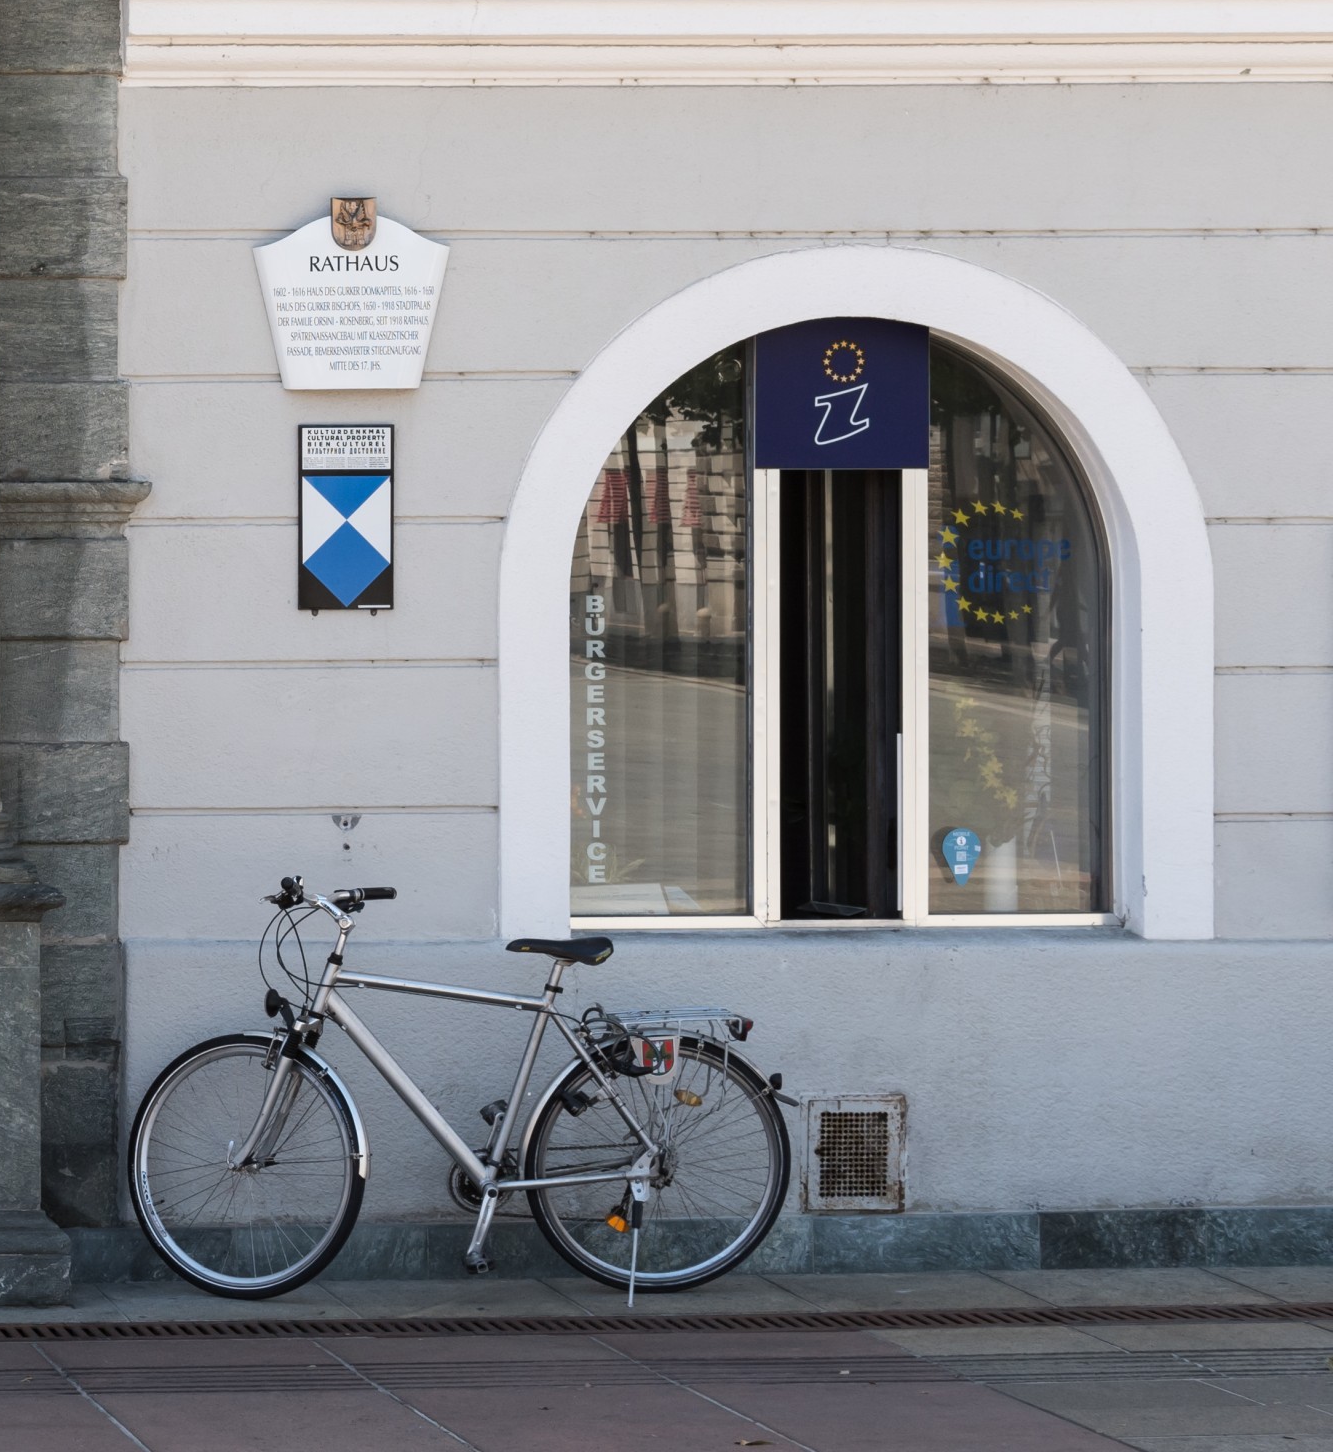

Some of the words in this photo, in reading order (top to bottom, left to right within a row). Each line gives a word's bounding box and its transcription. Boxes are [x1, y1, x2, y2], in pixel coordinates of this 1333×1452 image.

[310, 255, 399, 272] RATHAUS
[307, 286, 323, 296] HAUS
[324, 286, 336, 296] DES
[337, 286, 360, 296] GURKER
[276, 302, 293, 311] HAUS
[294, 302, 306, 311] DES
[307, 302, 330, 311] GURKER
[381, 301, 395, 310] 1918
[396, 301, 431, 310] STADTPALAIS
[277, 317, 289, 326] DER
[290, 317, 312, 326] FAMILIE
[313, 317, 334, 326] ORSINI
[339, 316, 375, 327] ROSENBERG,
[376, 316, 388, 325] SEIT
[389, 316, 402, 325] 1918
[356, 331, 368, 340] MIT
[369, 331, 419, 340] KLASSIZISTISCHER
[314, 346, 370, 356] BEMERKENSWERTER
[371, 345, 422, 355] STIEGENAUFGANG
[329, 361, 347, 370] MITTE
[348, 361, 359, 370] DES
[967, 538, 1071, 568] europe
[967, 562, 1052, 593] direct
[584, 595, 607, 884] BÜRGERSERVICE
